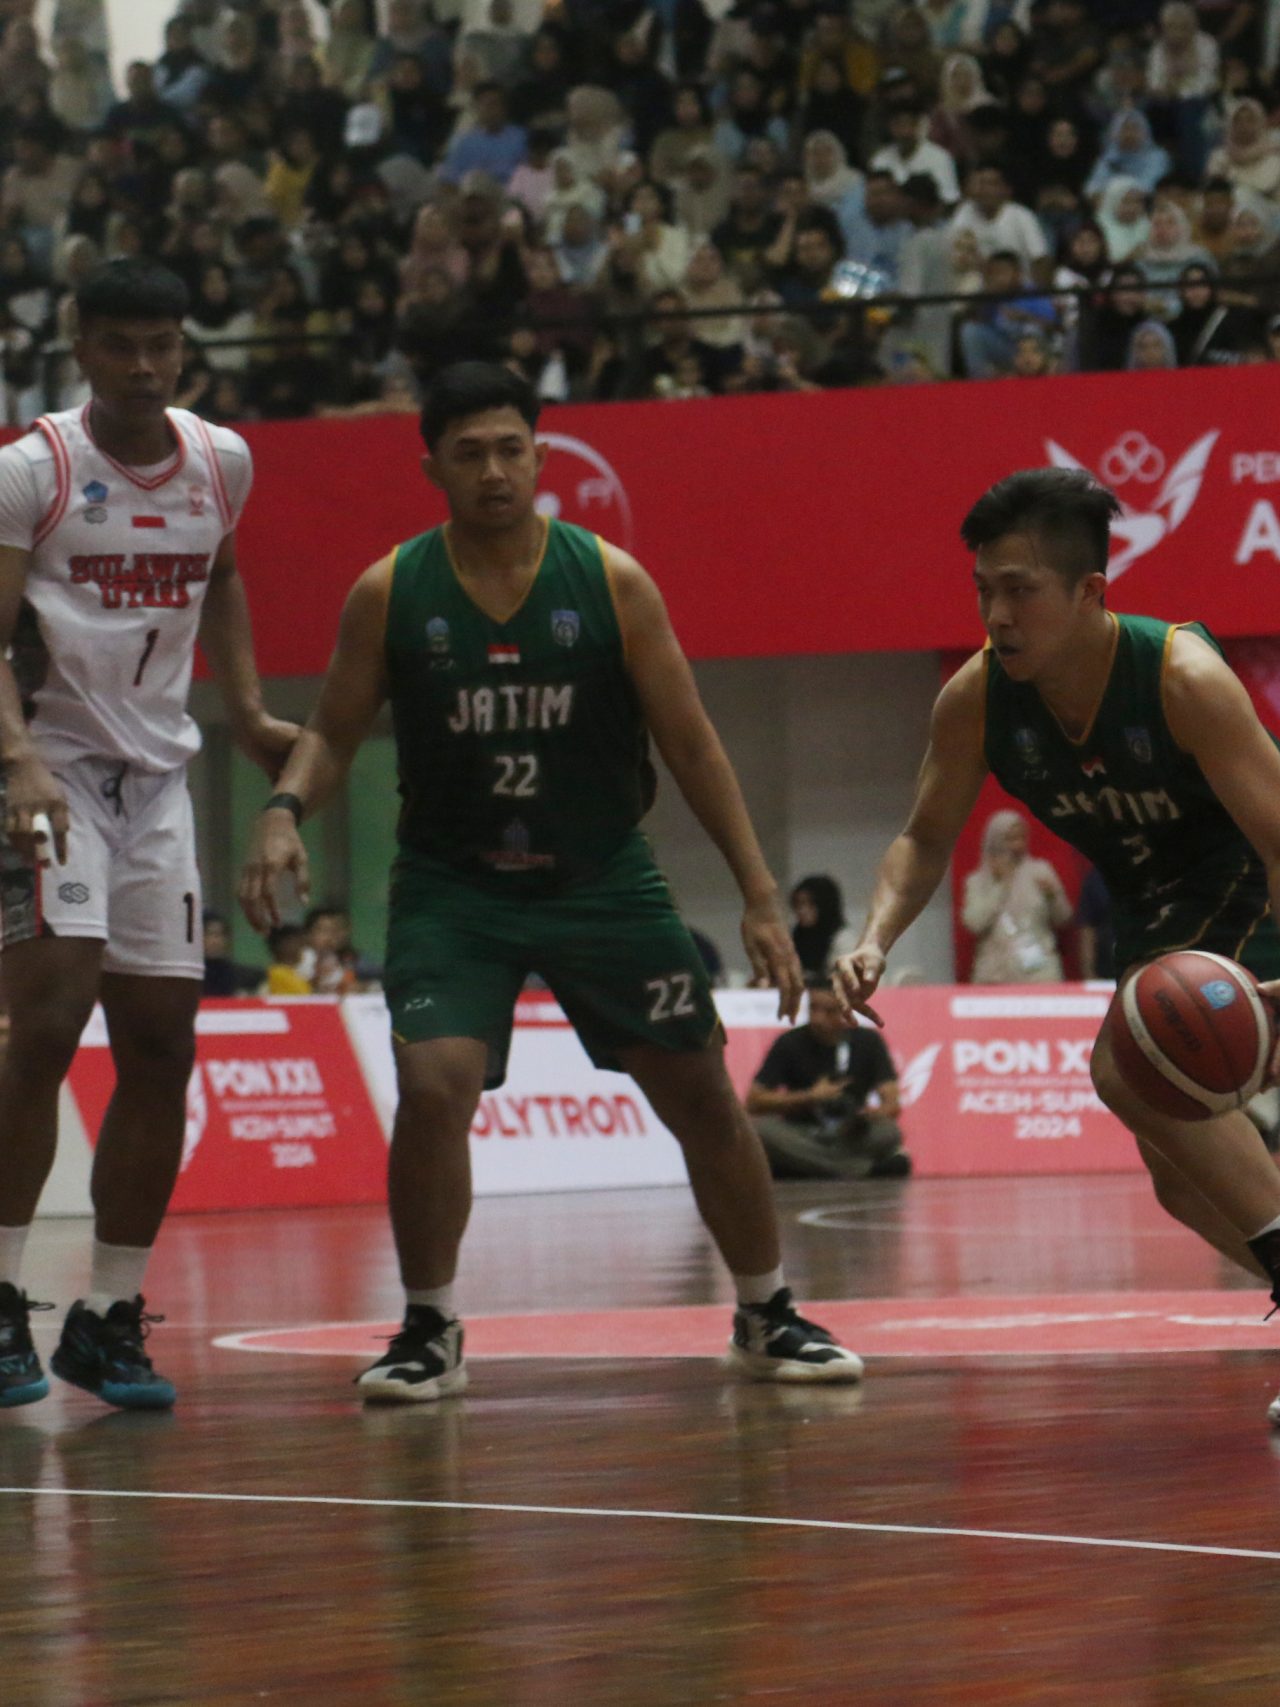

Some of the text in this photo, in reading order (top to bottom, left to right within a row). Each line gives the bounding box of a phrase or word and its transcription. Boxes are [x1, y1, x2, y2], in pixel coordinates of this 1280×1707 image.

[132, 628, 160, 687] 1
[449, 684, 575, 733] JATIM
[492, 753, 539, 797] 22
[182, 891, 195, 944] 1
[646, 972, 697, 1023] 22
[953, 1039, 1049, 1074] PON
[1014, 1116, 1083, 1138] 2024
